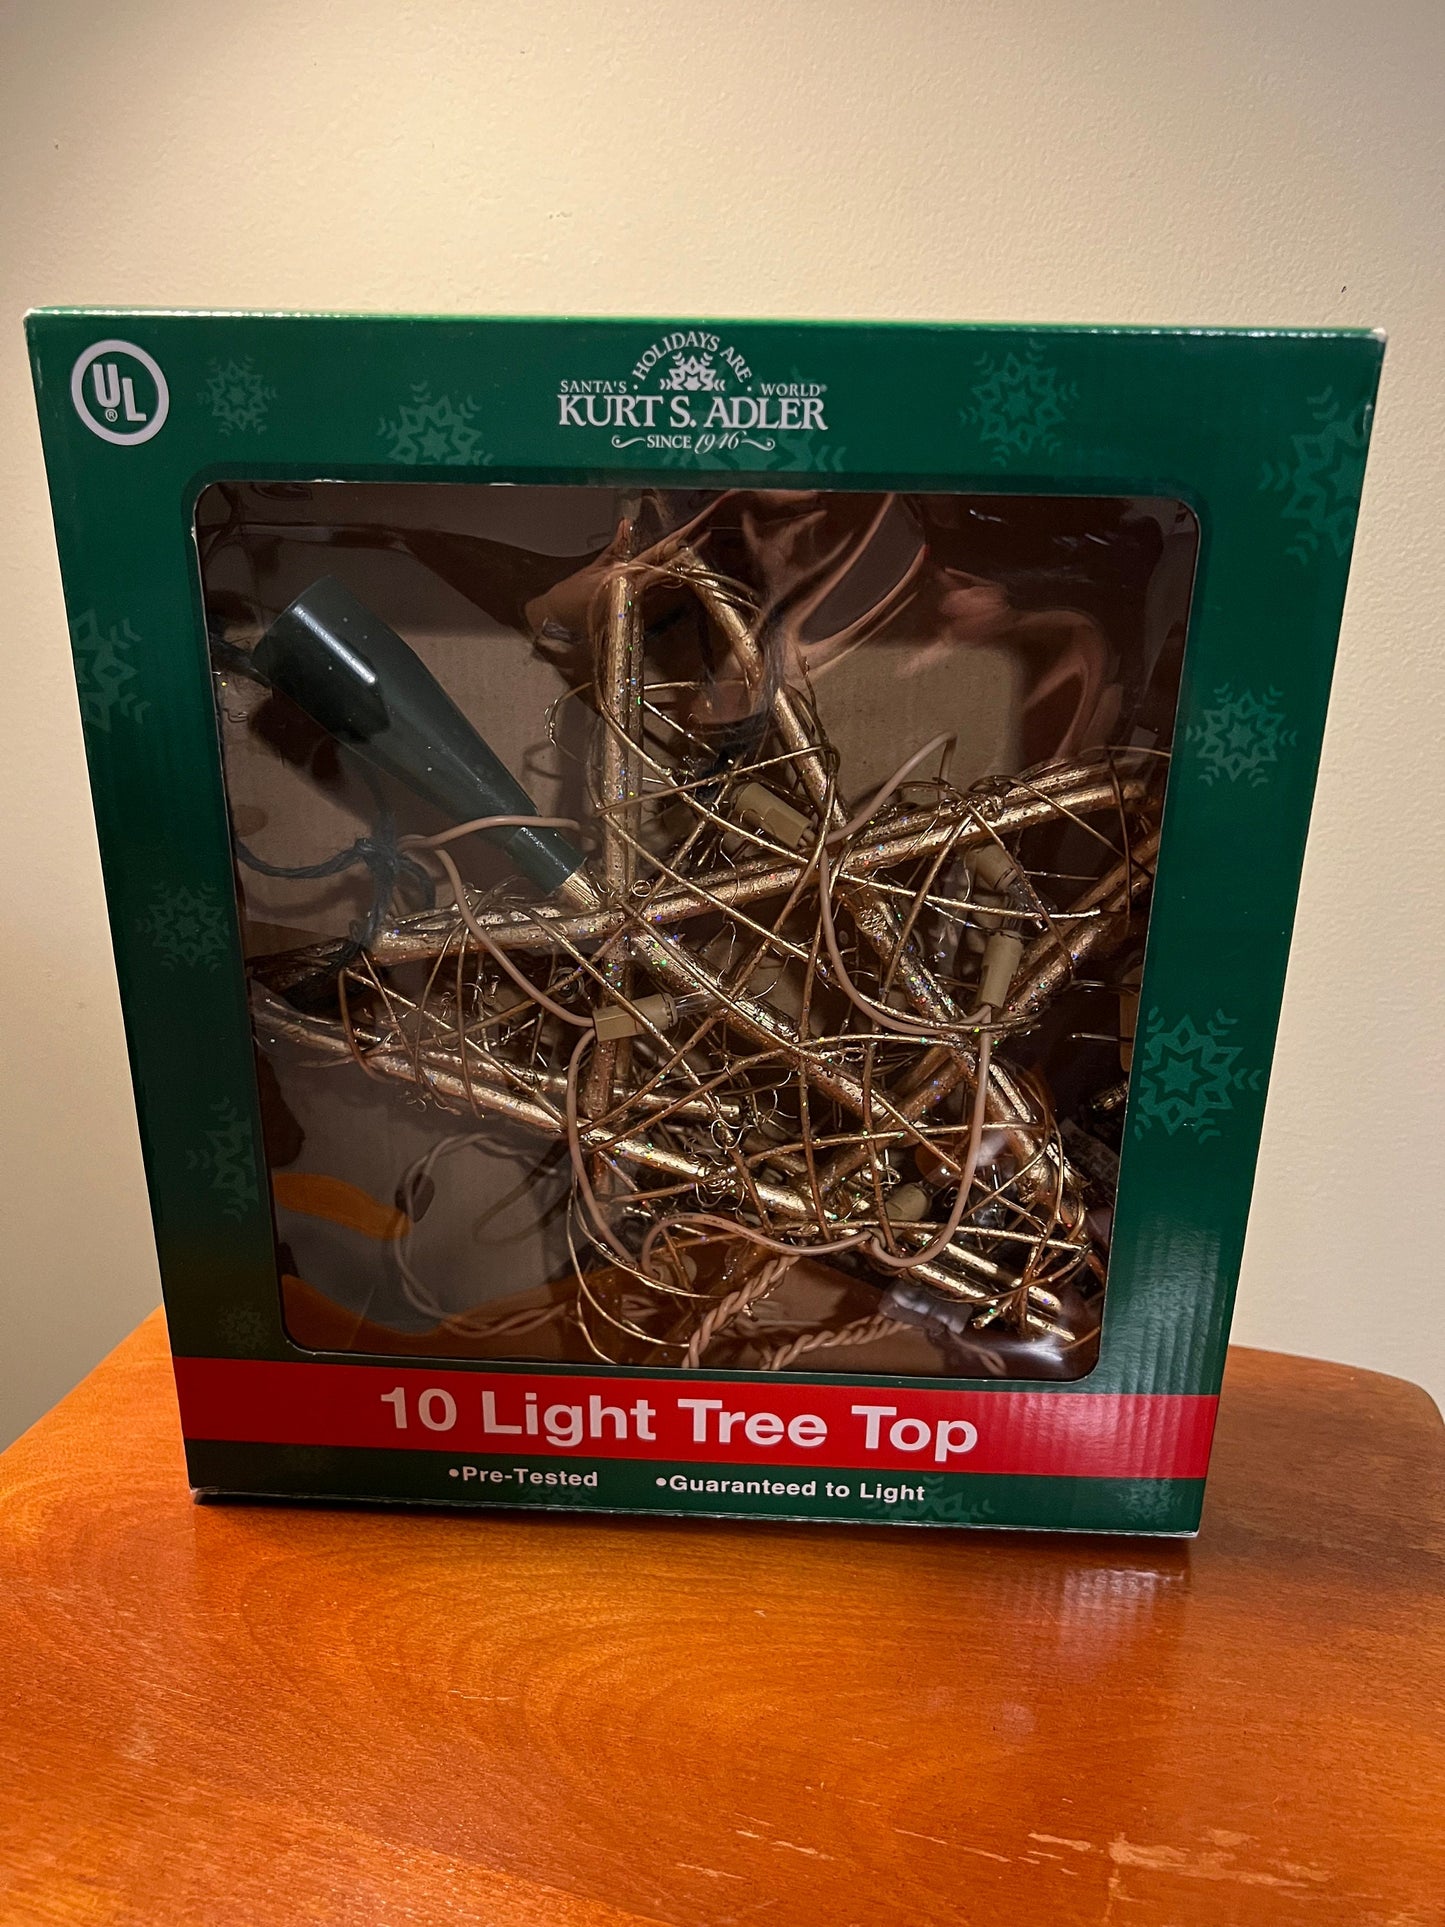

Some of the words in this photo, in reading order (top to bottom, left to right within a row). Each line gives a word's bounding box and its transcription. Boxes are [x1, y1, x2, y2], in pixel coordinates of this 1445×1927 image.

[632, 331, 721, 381] HOLIDAYS
[720, 346, 752, 383] ARE
[93, 364, 146, 421] UL
[560, 380, 627, 393] SANTA'S
[557, 394, 663, 427] KURT
[670, 396, 696, 428] S.
[704, 396, 829, 430] ADLER
[646, 434, 692, 449] SINCE
[694, 430, 747, 454] 1946
[380, 1386, 457, 1431] 10
[482, 1390, 656, 1447] Light
[677, 1398, 828, 1447] Tree
[851, 1405, 978, 1462] Top
[826, 1481, 849, 1499] to
[860, 1482, 925, 1502] Light
